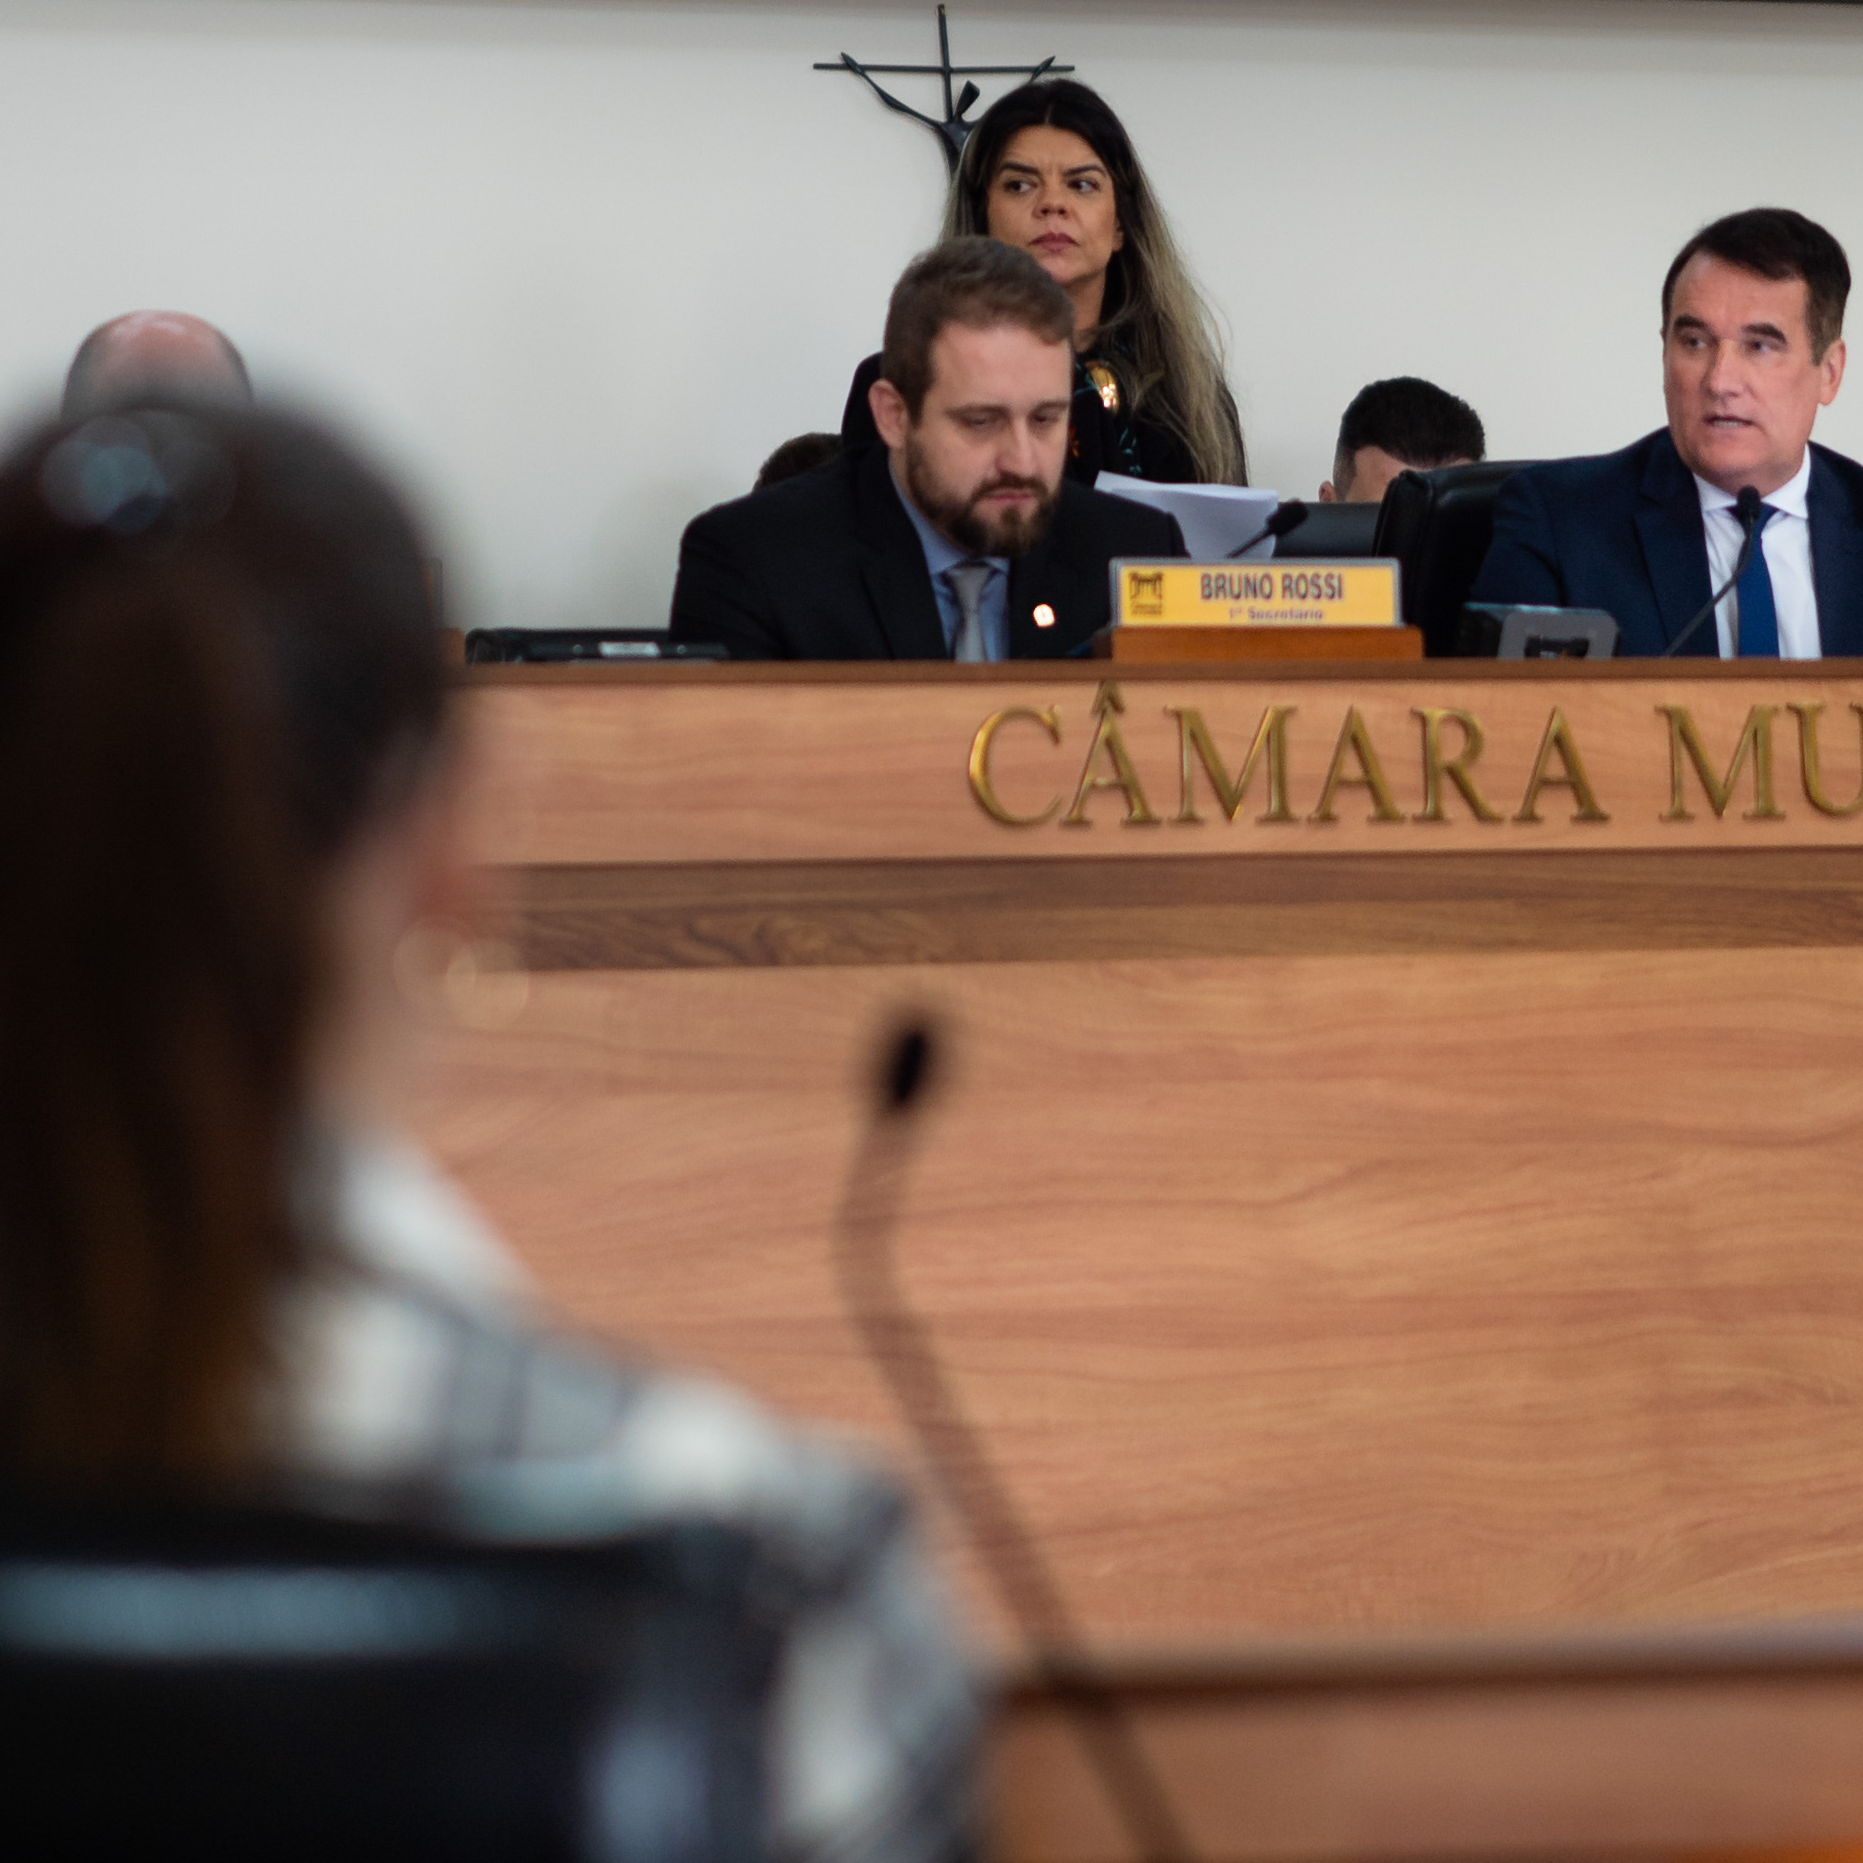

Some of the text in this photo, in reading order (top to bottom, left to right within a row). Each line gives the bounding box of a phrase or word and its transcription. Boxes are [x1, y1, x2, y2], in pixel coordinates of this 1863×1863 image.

[1200, 573, 1342, 600] BRUNO ROSSI
[968, 680, 1610, 826] CÂMARA
